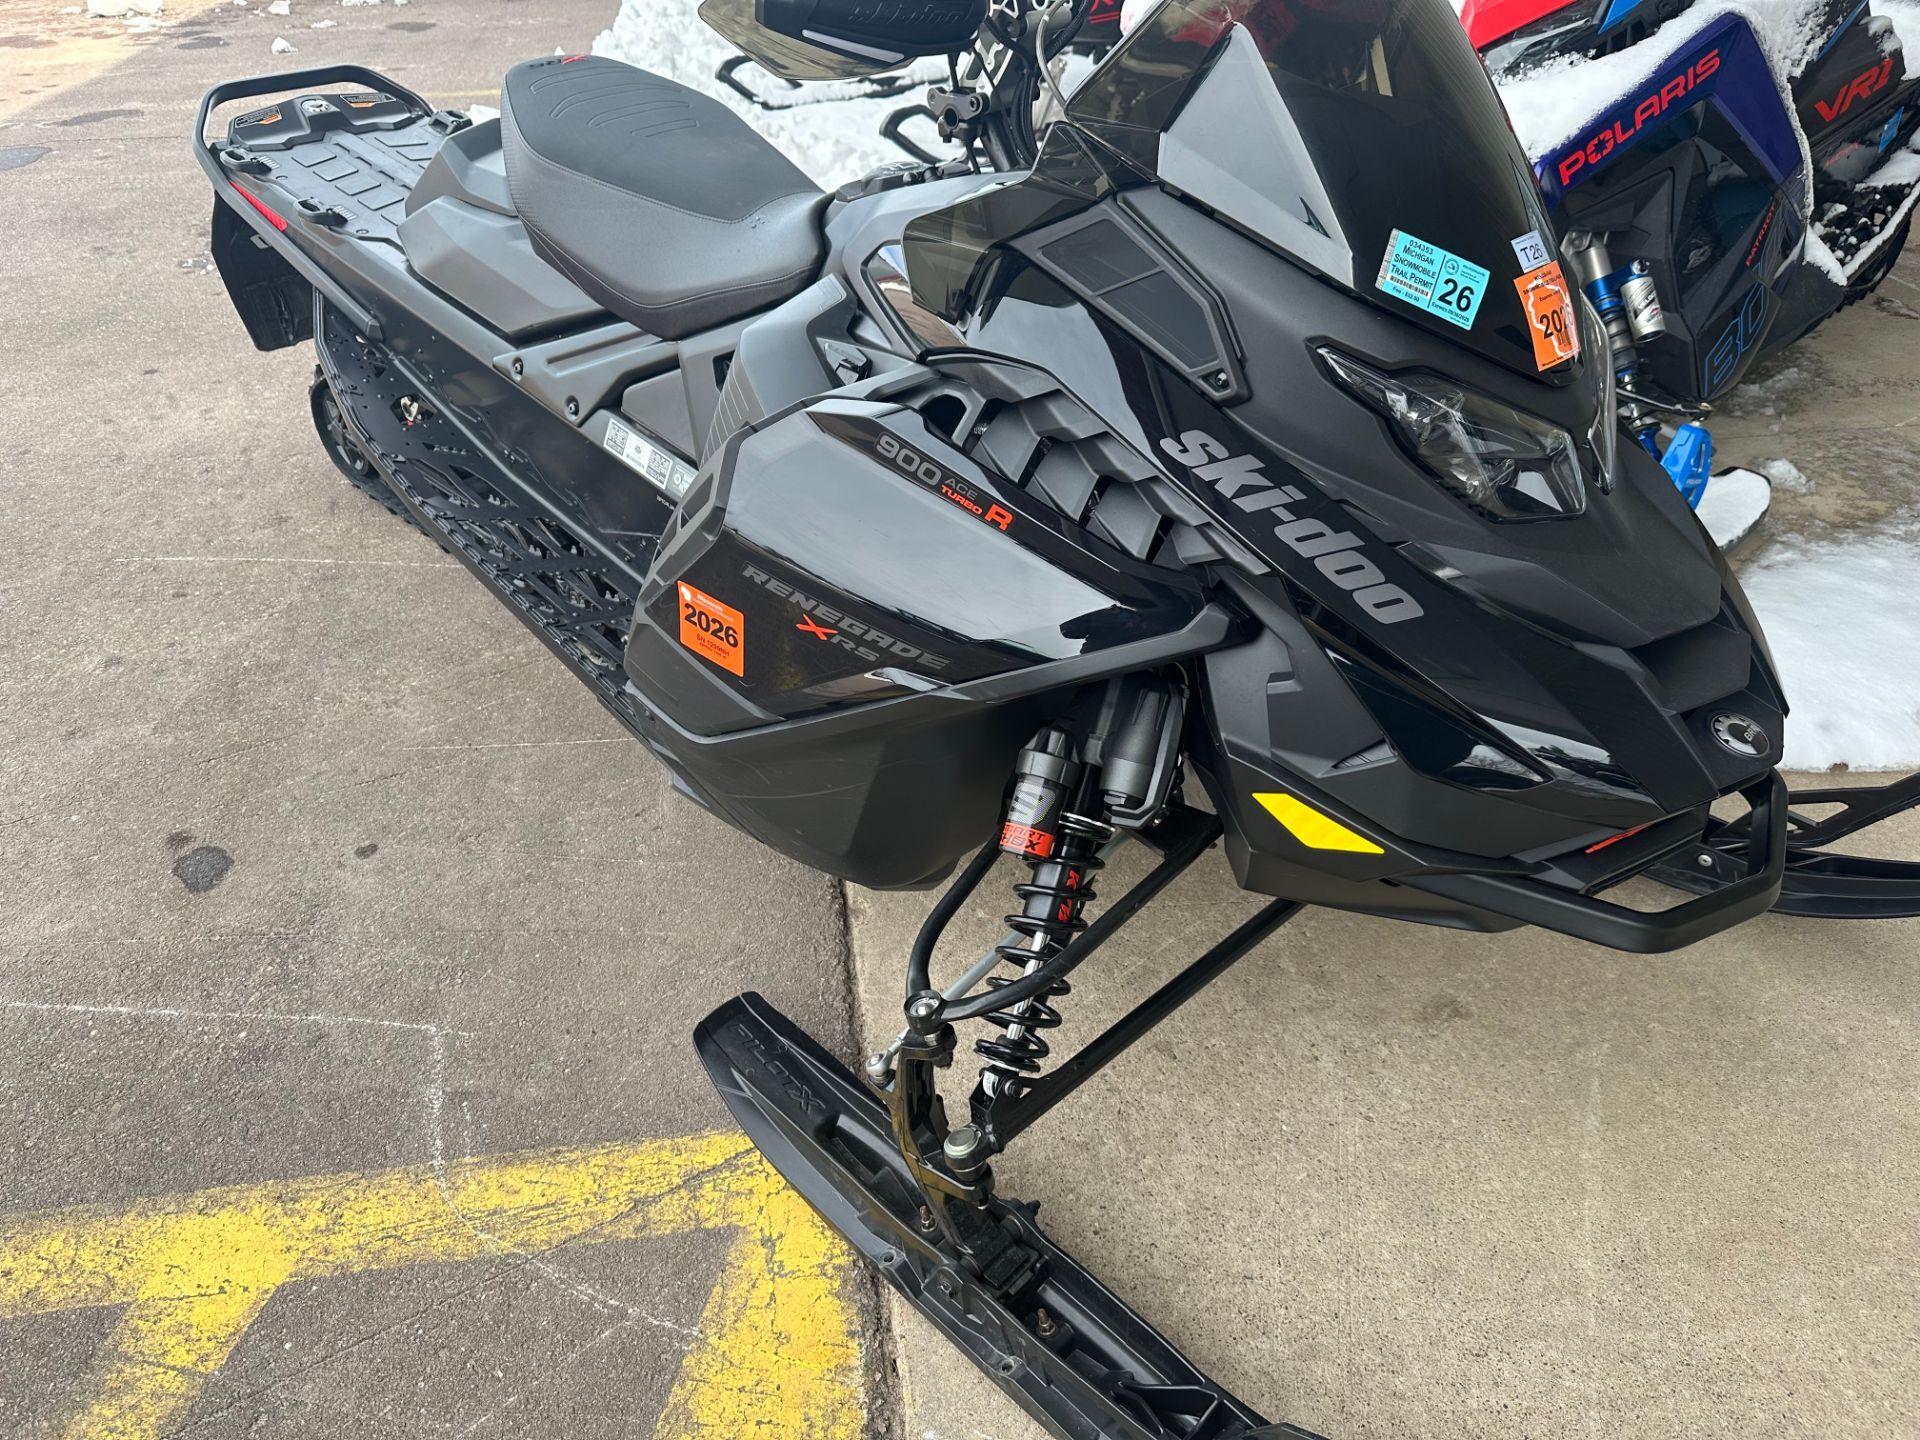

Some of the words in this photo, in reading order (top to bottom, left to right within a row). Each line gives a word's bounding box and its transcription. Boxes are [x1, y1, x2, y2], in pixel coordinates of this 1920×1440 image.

[1558, 48, 1722, 187] POLARIS
[1745, 202, 1777, 268] PATRIOT
[1393, 253, 1438, 280] SNOWMOBILE
[1402, 244, 1436, 266] MICHIGAN
[1390, 264, 1408, 280] TRAIL
[1409, 273, 1434, 290] PERMIT
[1437, 277, 1475, 312] 26
[876, 434, 942, 486] 900
[940, 484, 983, 515] TURBO
[944, 477, 979, 500] ACE
[984, 504, 1014, 531] R
[684, 602, 739, 648] 2026
[742, 564, 951, 670] RENEGADE
